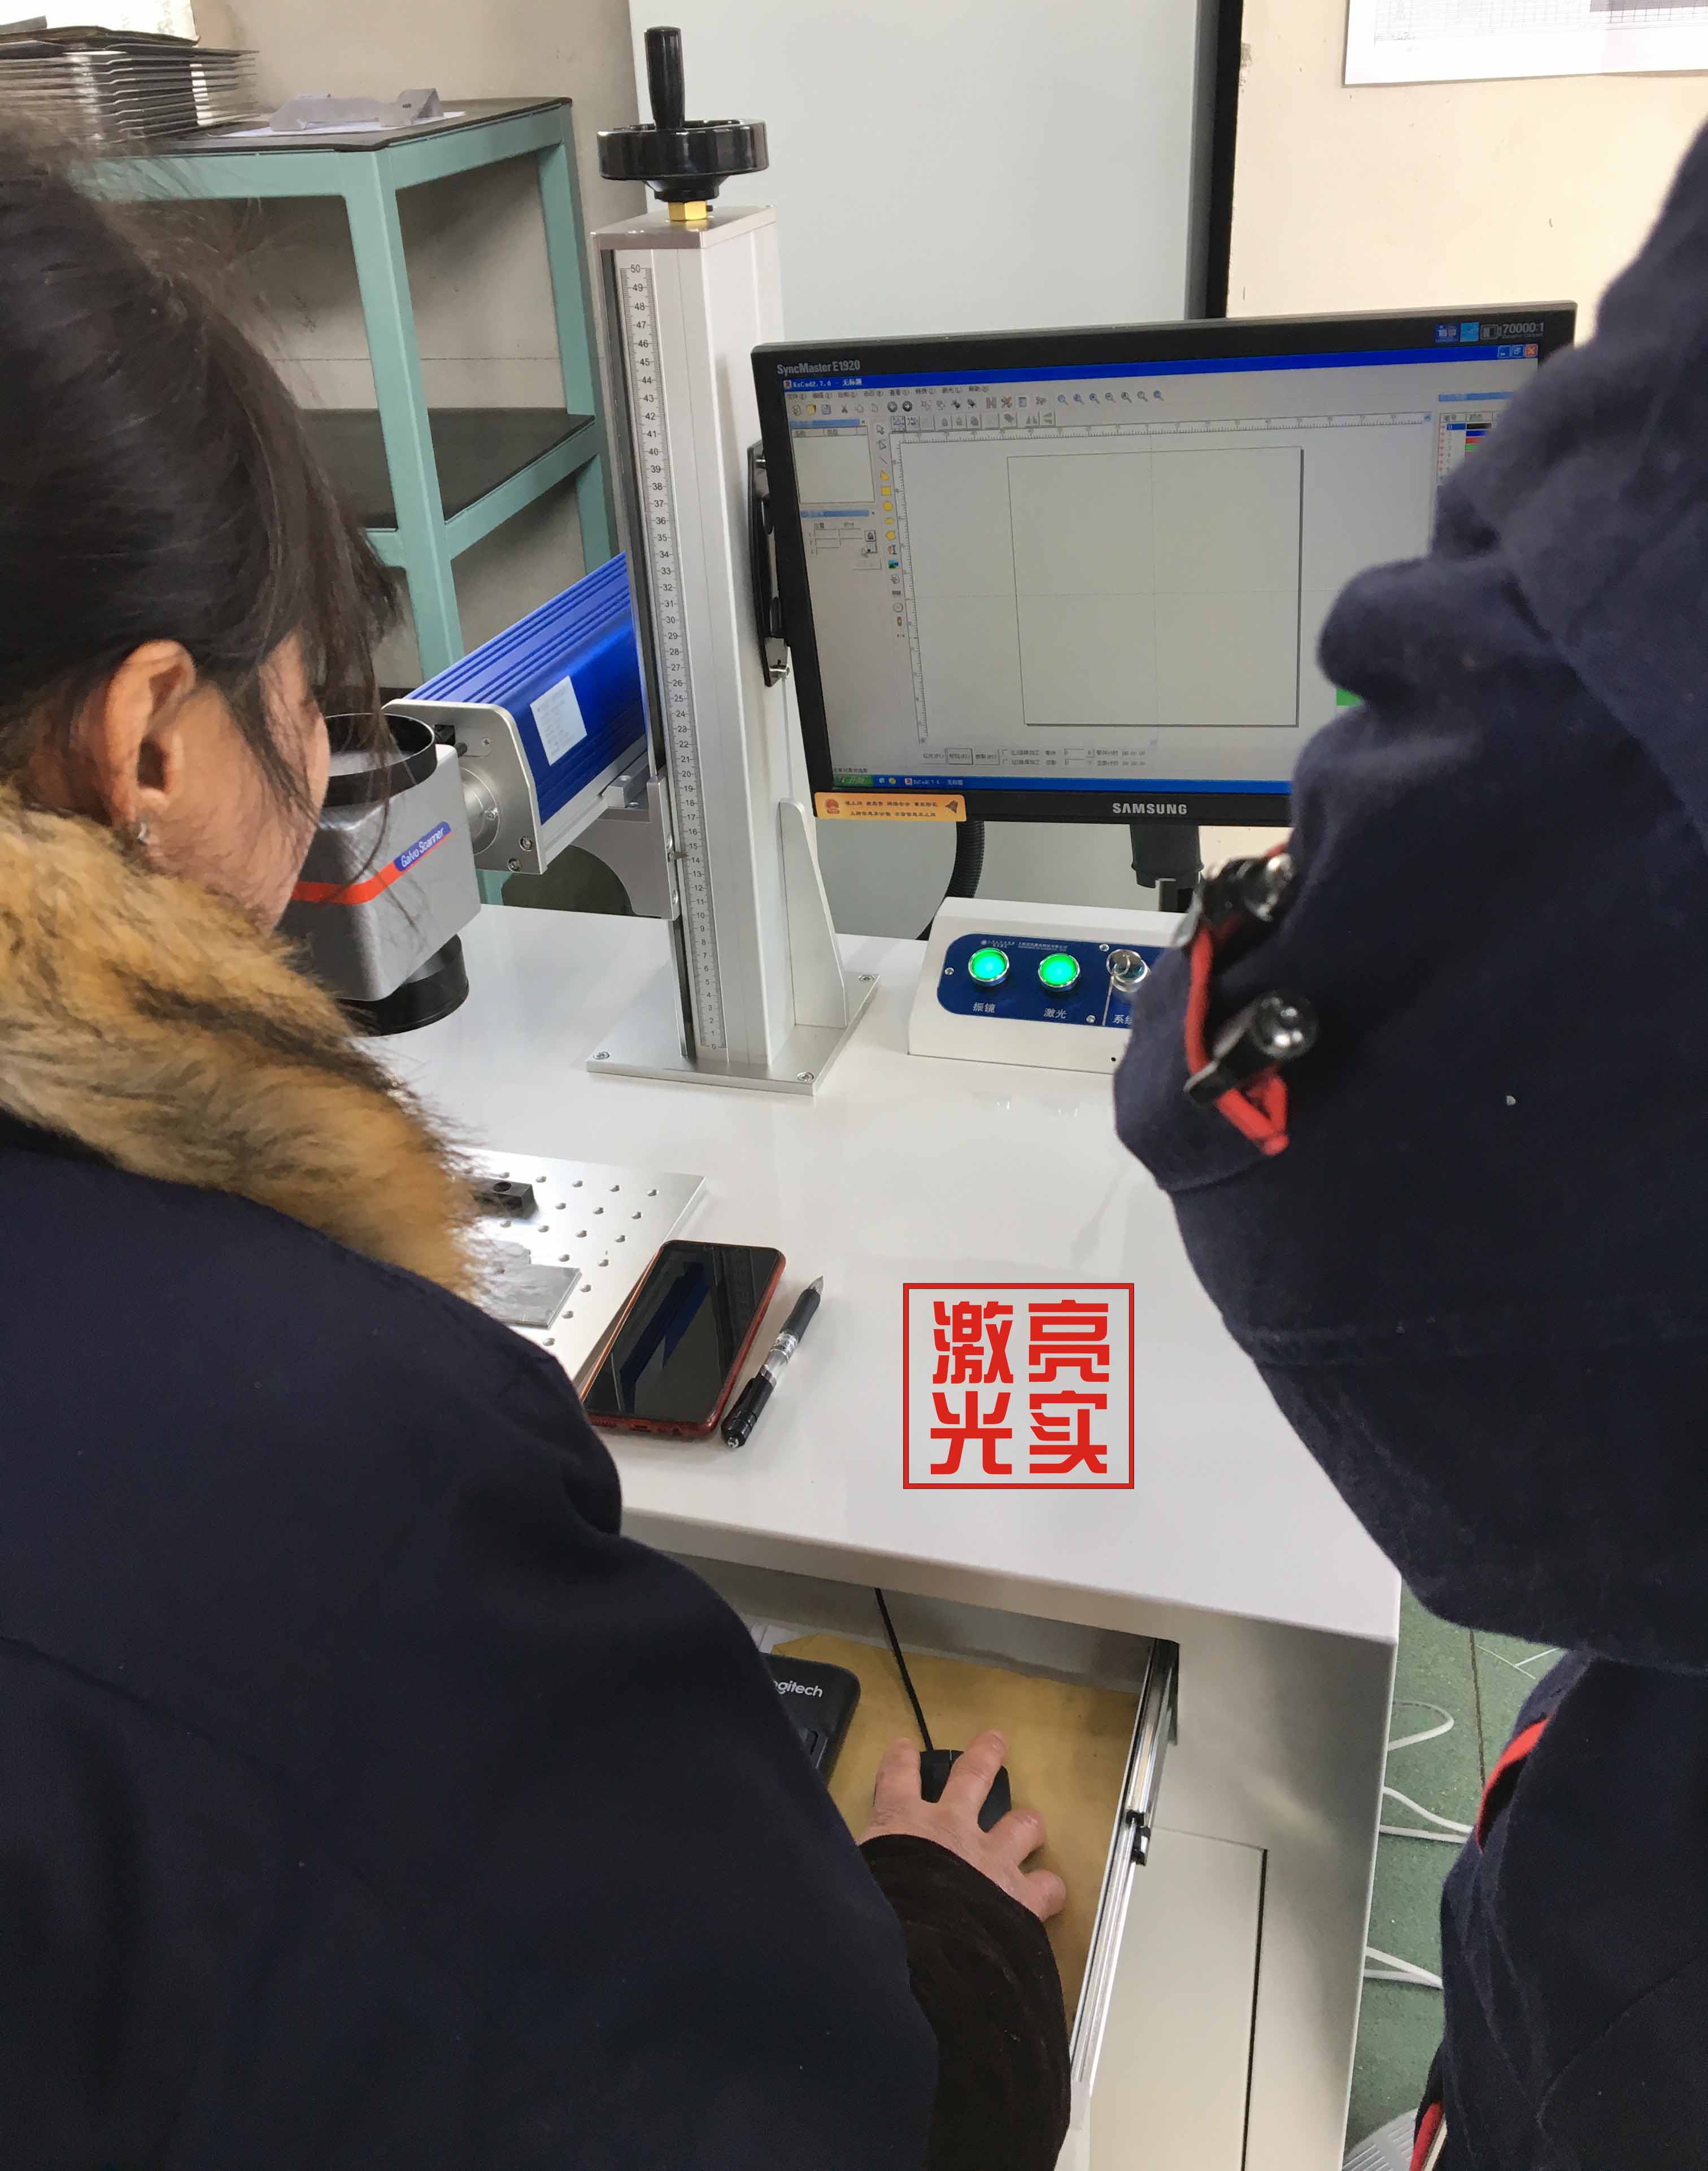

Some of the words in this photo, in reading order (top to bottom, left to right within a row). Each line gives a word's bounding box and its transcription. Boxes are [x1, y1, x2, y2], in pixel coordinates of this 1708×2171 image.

[631, 264, 640, 273] 50
[638, 340, 648, 348] 46
[777, 362, 831, 376] SyncMaster
[833, 359, 860, 372] E1920
[1112, 803, 1187, 815] SAMSUNG
[400, 849, 420, 868] Galvo
[419, 827, 444, 854] Scanner
[1043, 1008, 1067, 1019] 激光
[773, 1680, 823, 1698] gitech
